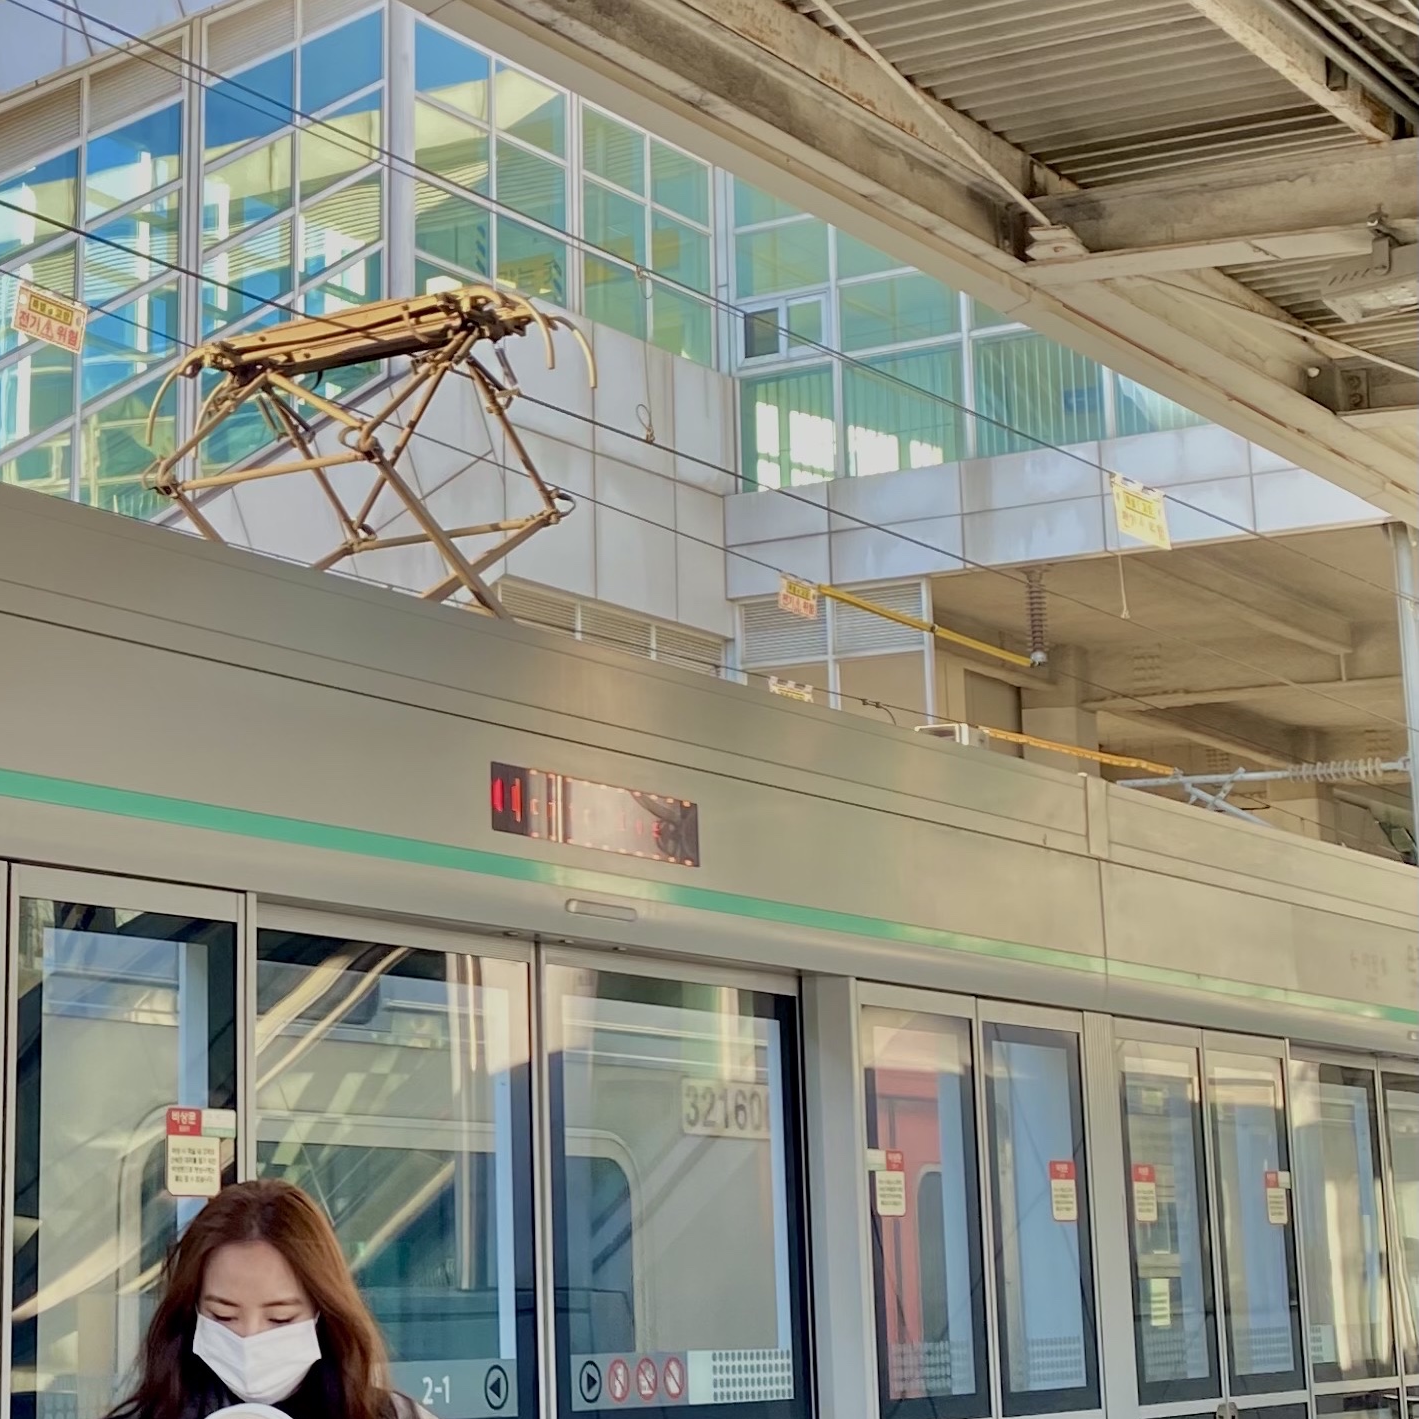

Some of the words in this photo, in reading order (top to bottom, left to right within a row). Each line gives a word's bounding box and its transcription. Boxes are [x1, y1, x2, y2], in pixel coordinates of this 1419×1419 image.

[18, 311, 41, 332] 전기
[57, 325, 79, 347] 위험
[171, 1110, 197, 1125] 비상문
[422, 1375, 450, 1405] 2-1
